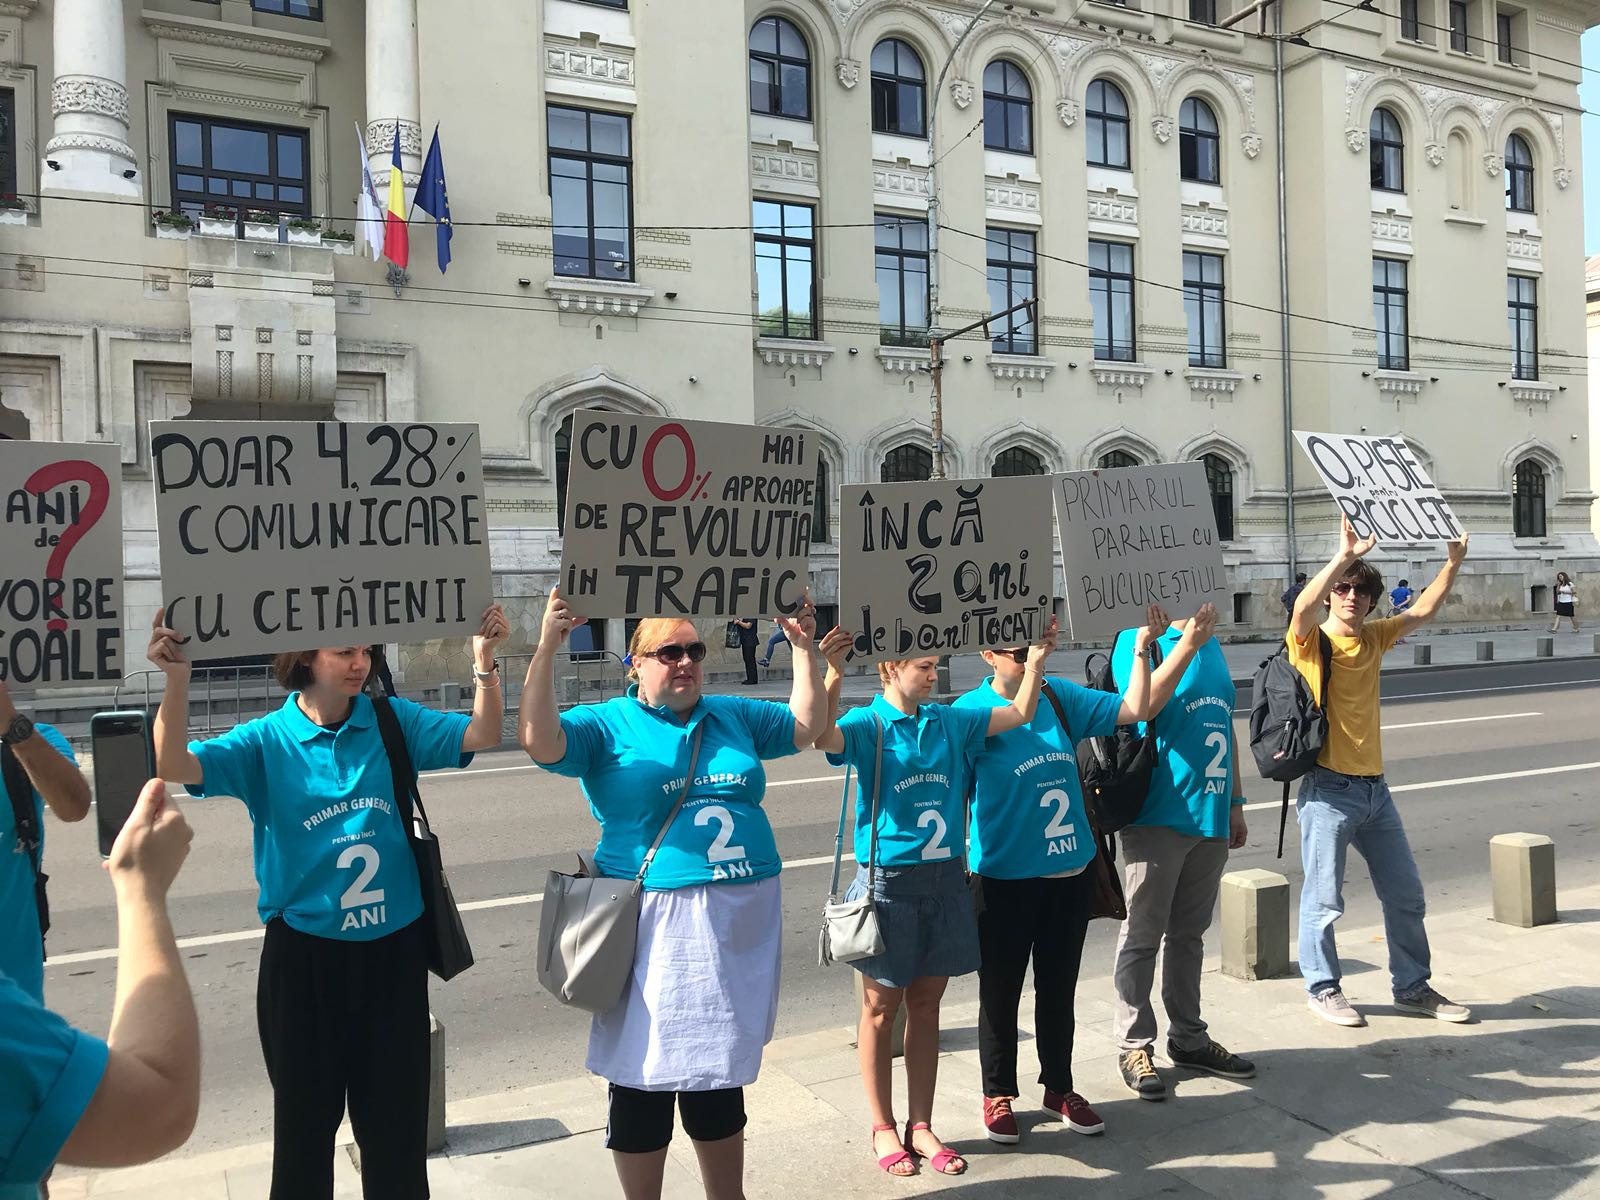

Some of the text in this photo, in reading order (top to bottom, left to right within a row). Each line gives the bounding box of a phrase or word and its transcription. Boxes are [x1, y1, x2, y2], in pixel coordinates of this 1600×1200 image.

[151, 432, 293, 493] DOAR
[580, 422, 638, 470] CU
[1343, 438, 1435, 492] PISTE
[722, 475, 815, 507] APROAPE
[34, 527, 60, 547] de
[179, 495, 482, 554] COMUNICARE
[575, 503, 608, 529] DE
[859, 483, 984, 552] ÎNCĂ
[1091, 524, 1186, 560] PARALEL
[164, 593, 230, 645] CU
[851, 604, 886, 658] de
[895, 611, 971, 656] bani
[0, 627, 122, 683] OALE
[1013, 755, 1046, 777] PRIMAR
[1204, 731, 1227, 778] 2
[694, 772, 748, 787] GENERAL
[893, 774, 924, 794] PRIMAR
[303, 797, 391, 832] PRIMAR GENERAL
[694, 805, 746, 863] 2
[916, 809, 951, 861] 2
[1039, 788, 1075, 839] 2
[332, 834, 360, 845] PENTRU
[1046, 836, 1078, 857] ANI
[336, 843, 385, 910] 2
[711, 860, 753, 882] ANI
[340, 904, 386, 932] ANI
